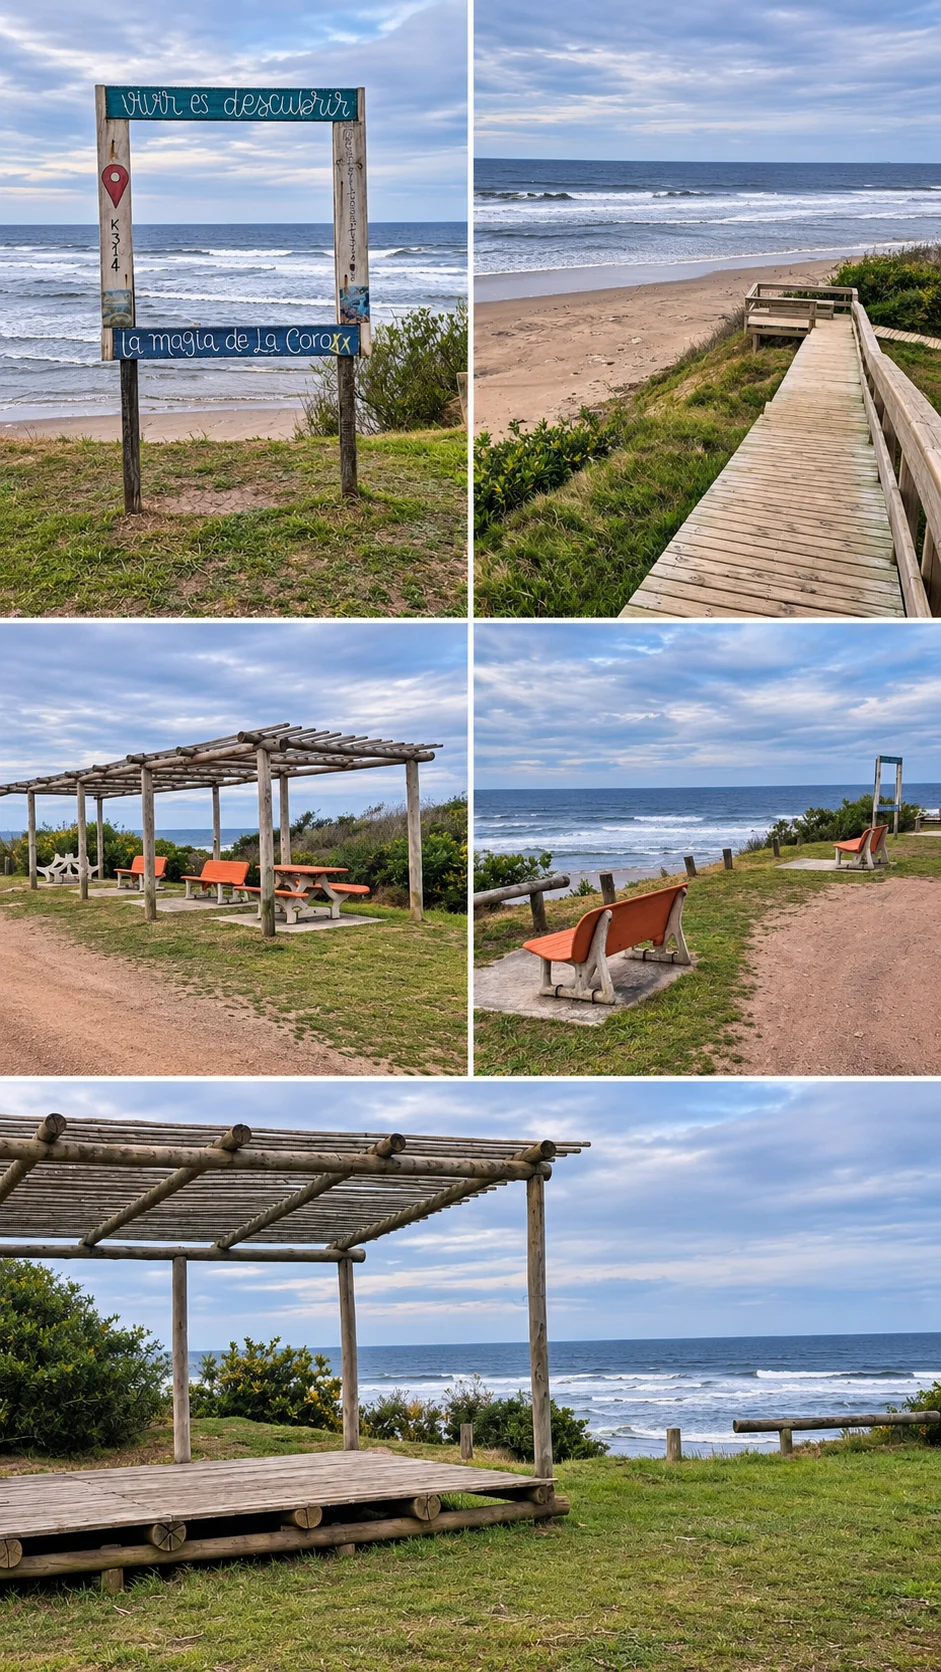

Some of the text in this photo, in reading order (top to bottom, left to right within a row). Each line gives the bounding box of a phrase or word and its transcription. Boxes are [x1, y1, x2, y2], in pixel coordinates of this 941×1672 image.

[121, 90, 351, 118] vivir es descubrir
[148, 330, 220, 357] magia
[225, 328, 250, 351] de
[253, 328, 281, 354] La
